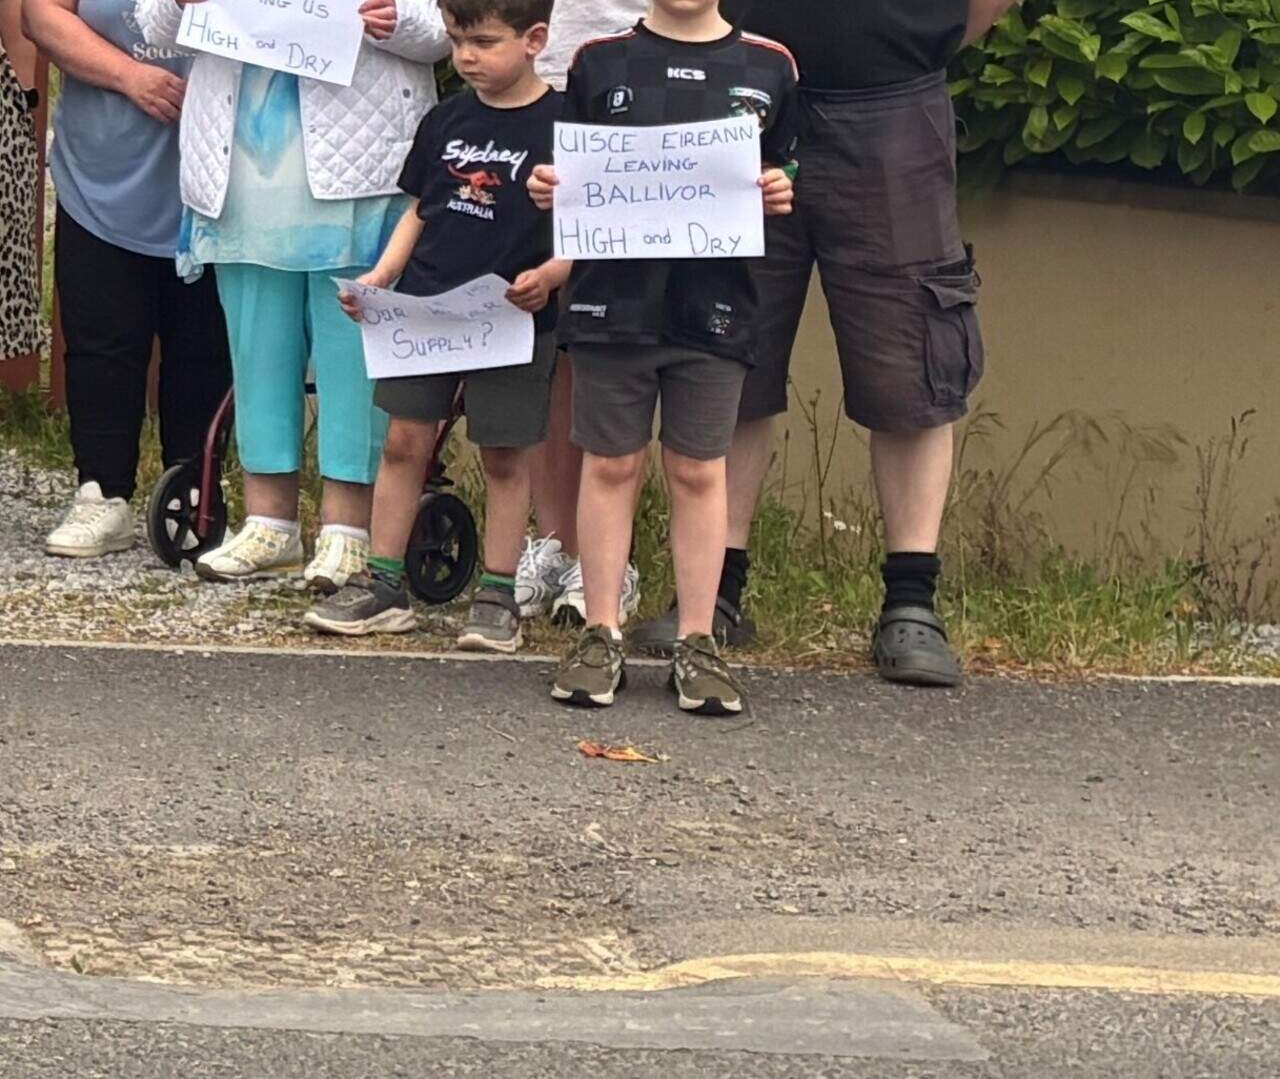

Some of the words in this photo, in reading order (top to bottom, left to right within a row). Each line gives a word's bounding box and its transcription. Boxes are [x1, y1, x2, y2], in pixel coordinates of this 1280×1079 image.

[186, 6, 238, 50] HIGH
[285, 42, 332, 75] DRY
[667, 67, 706, 80] KCS
[559, 128, 638, 153] UISCE
[661, 124, 754, 150] EIREANN
[441, 138, 530, 182] Sydney
[583, 181, 717, 208] BALLIVOR
[643, 228, 672, 245] and
[687, 221, 742, 256] DRY
